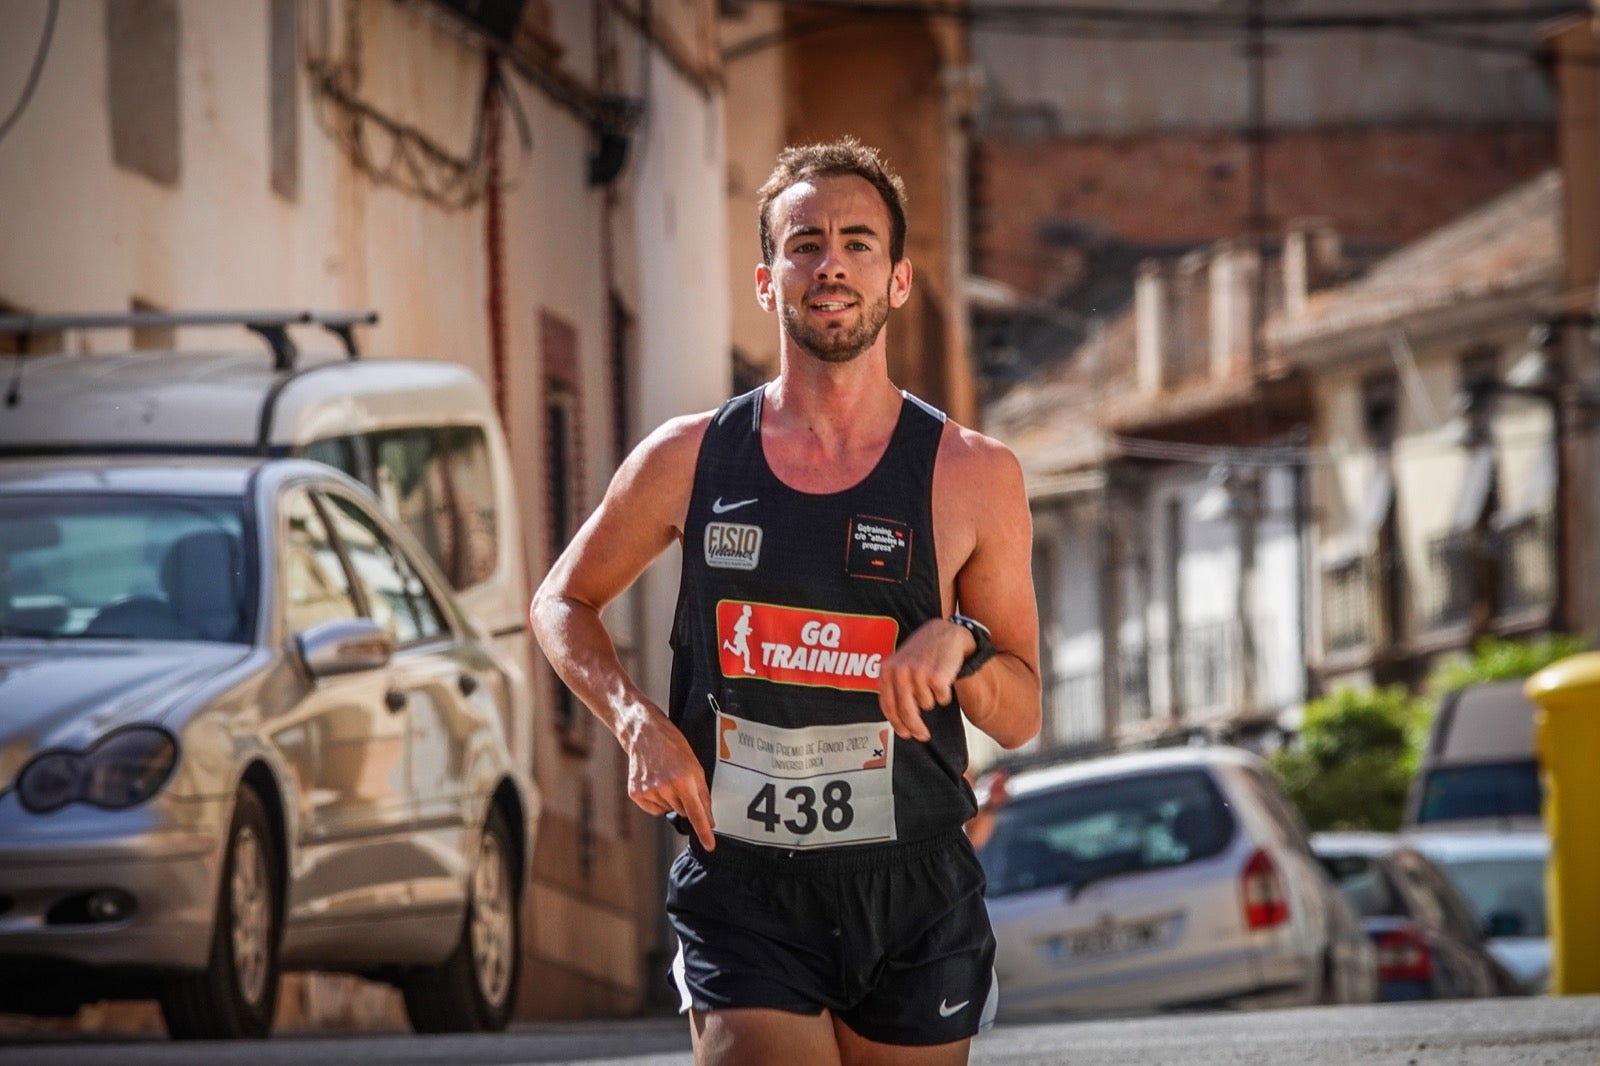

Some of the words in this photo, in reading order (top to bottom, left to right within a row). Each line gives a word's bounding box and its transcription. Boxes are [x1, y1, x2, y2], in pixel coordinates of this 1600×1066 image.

[709, 525, 758, 553] FISIO
[801, 621, 840, 648] GQ
[761, 642, 881, 678] TRAINING
[846, 735, 869, 751] 2022
[747, 780, 854, 835] 438
